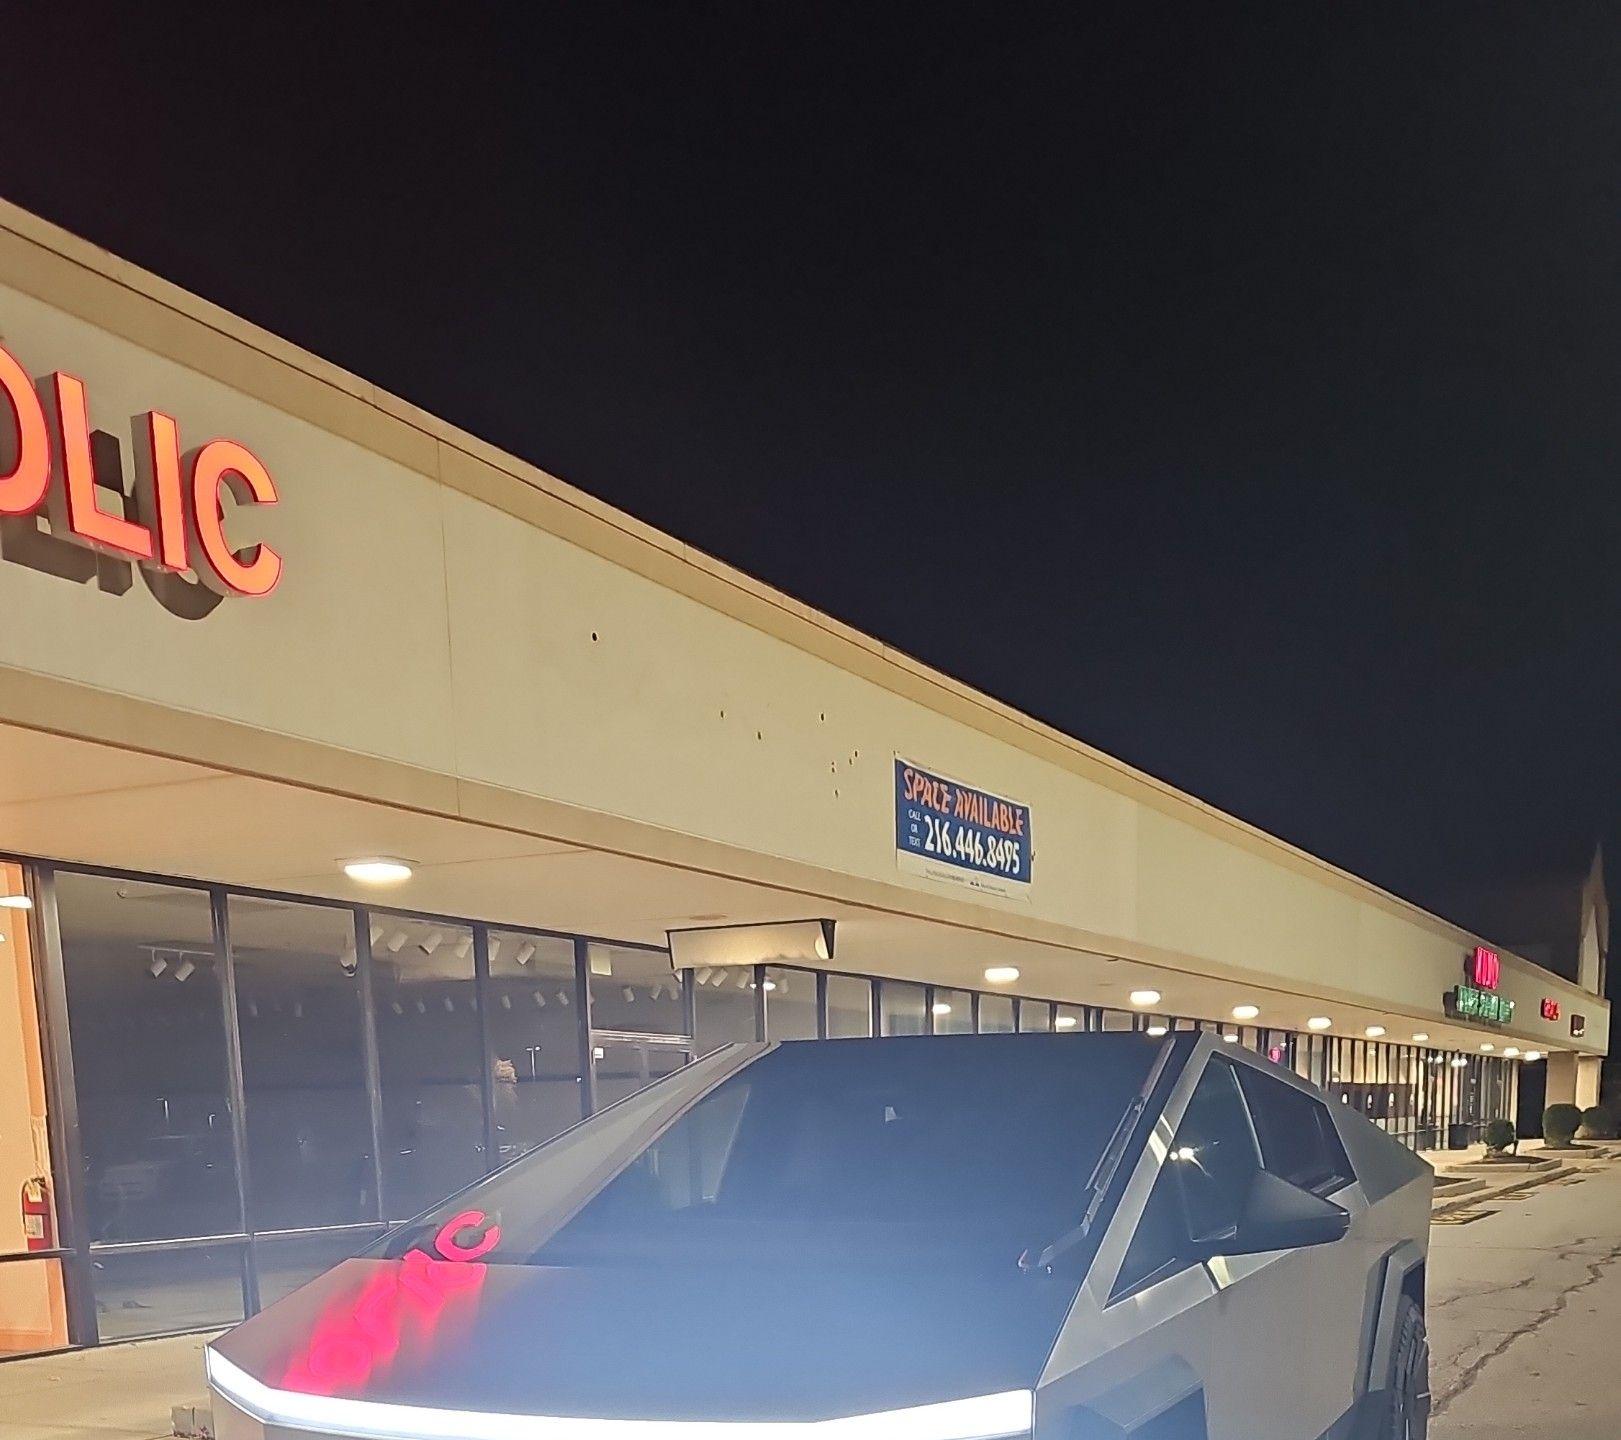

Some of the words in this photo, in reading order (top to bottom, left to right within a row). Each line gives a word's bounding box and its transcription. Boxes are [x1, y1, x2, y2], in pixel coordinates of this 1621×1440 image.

[903, 768, 952, 814] SPACE
[954, 788, 1024, 836] AVAILABLE
[908, 808, 921, 821] CALL
[924, 814, 1020, 875] 216.446.8495
